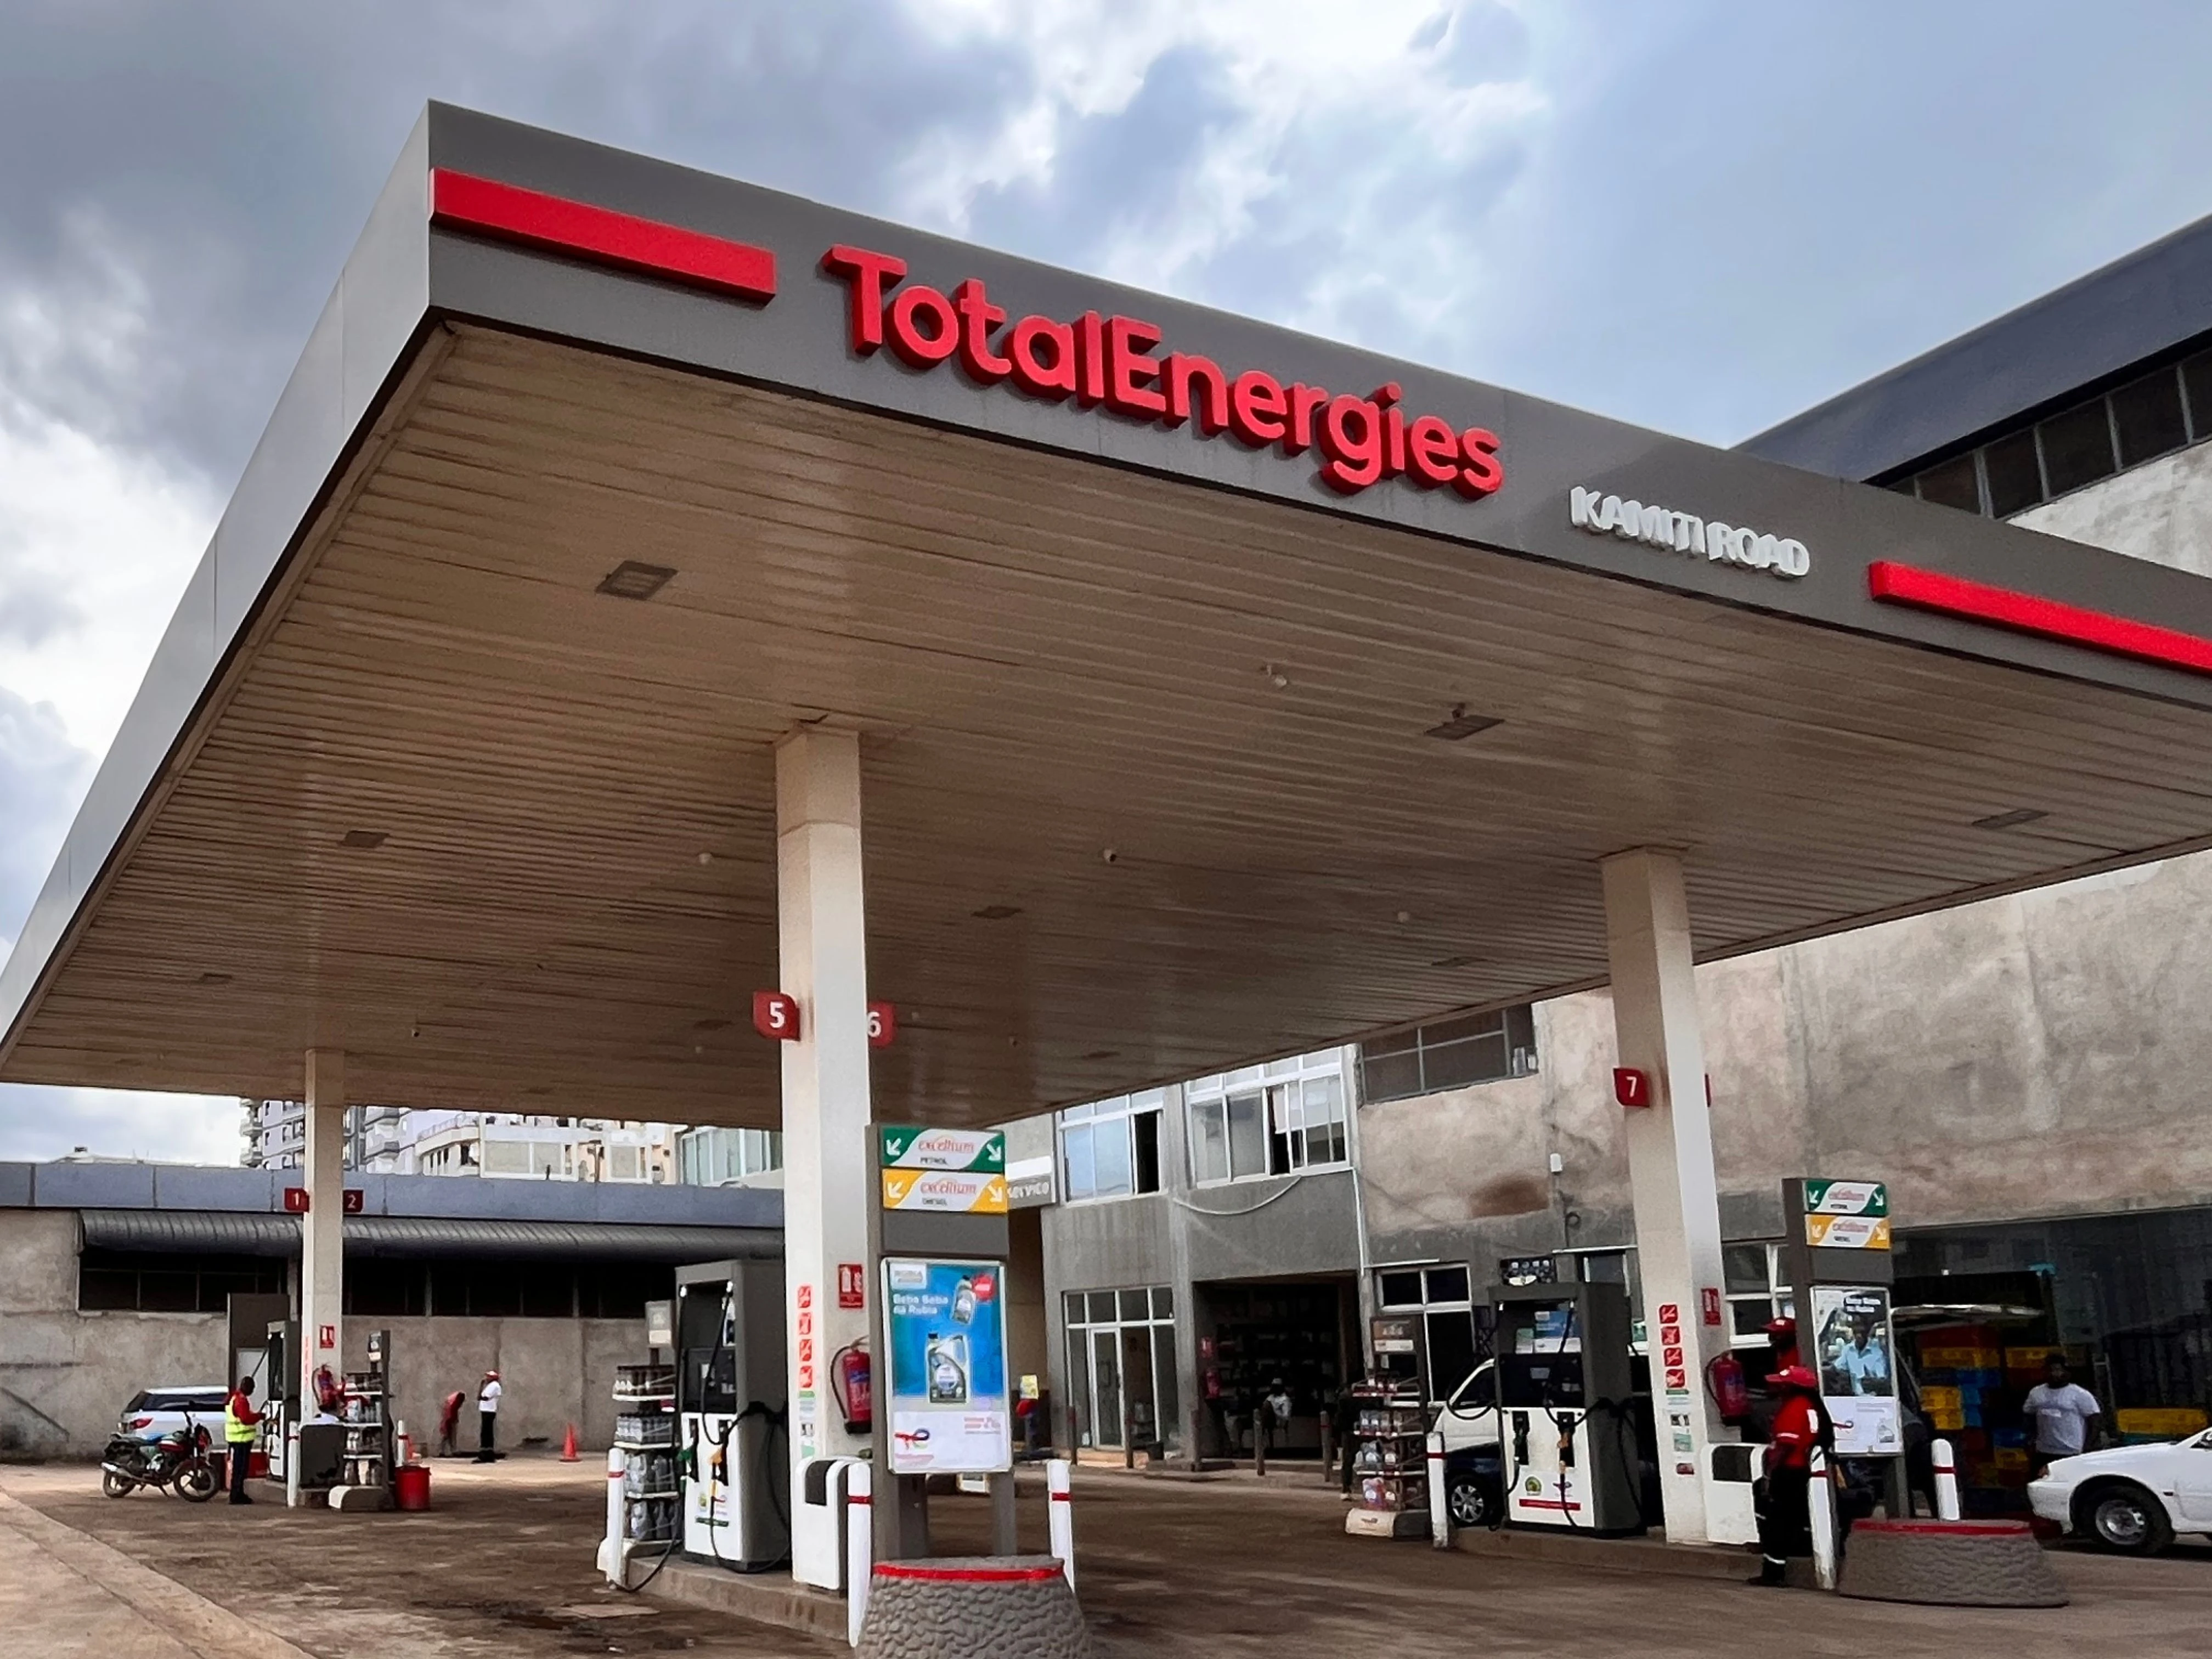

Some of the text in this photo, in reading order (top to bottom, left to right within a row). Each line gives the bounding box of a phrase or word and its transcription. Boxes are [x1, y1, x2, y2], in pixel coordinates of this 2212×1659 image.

[823, 243, 1503, 500] TotalEnergies
[1570, 486, 1810, 578] KAMITI ROAD
[769, 1001, 785, 1029] 5
[867, 1011, 881, 1037] 6
[1626, 1076, 1637, 1097] 7
[294, 1192, 300, 1206] 1
[347, 1194, 356, 1209] 2
